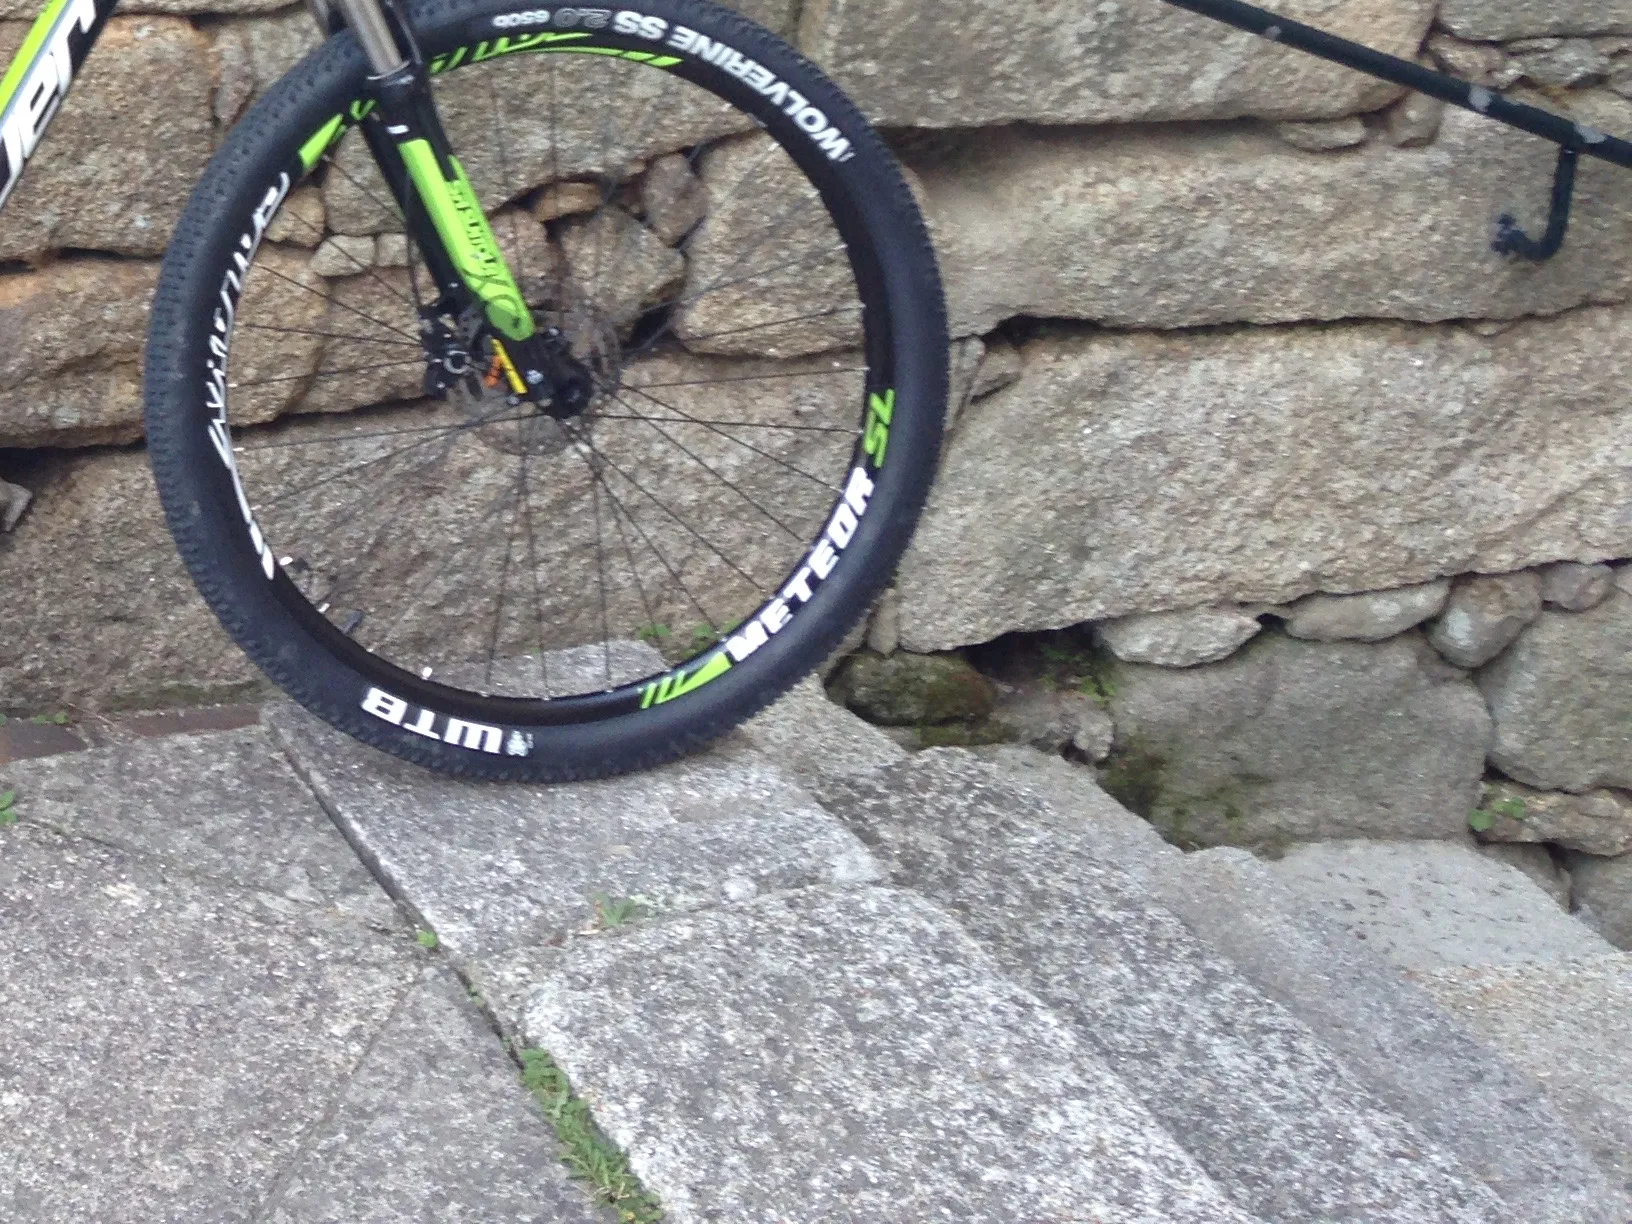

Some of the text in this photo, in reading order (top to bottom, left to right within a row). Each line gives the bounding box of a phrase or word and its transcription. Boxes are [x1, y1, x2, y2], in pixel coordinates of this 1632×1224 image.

[613, 10, 668, 40] SS
[668, 25, 852, 162] WOLVERINE
[725, 387, 896, 662] METEOR SL
[360, 687, 503, 754] WTB
